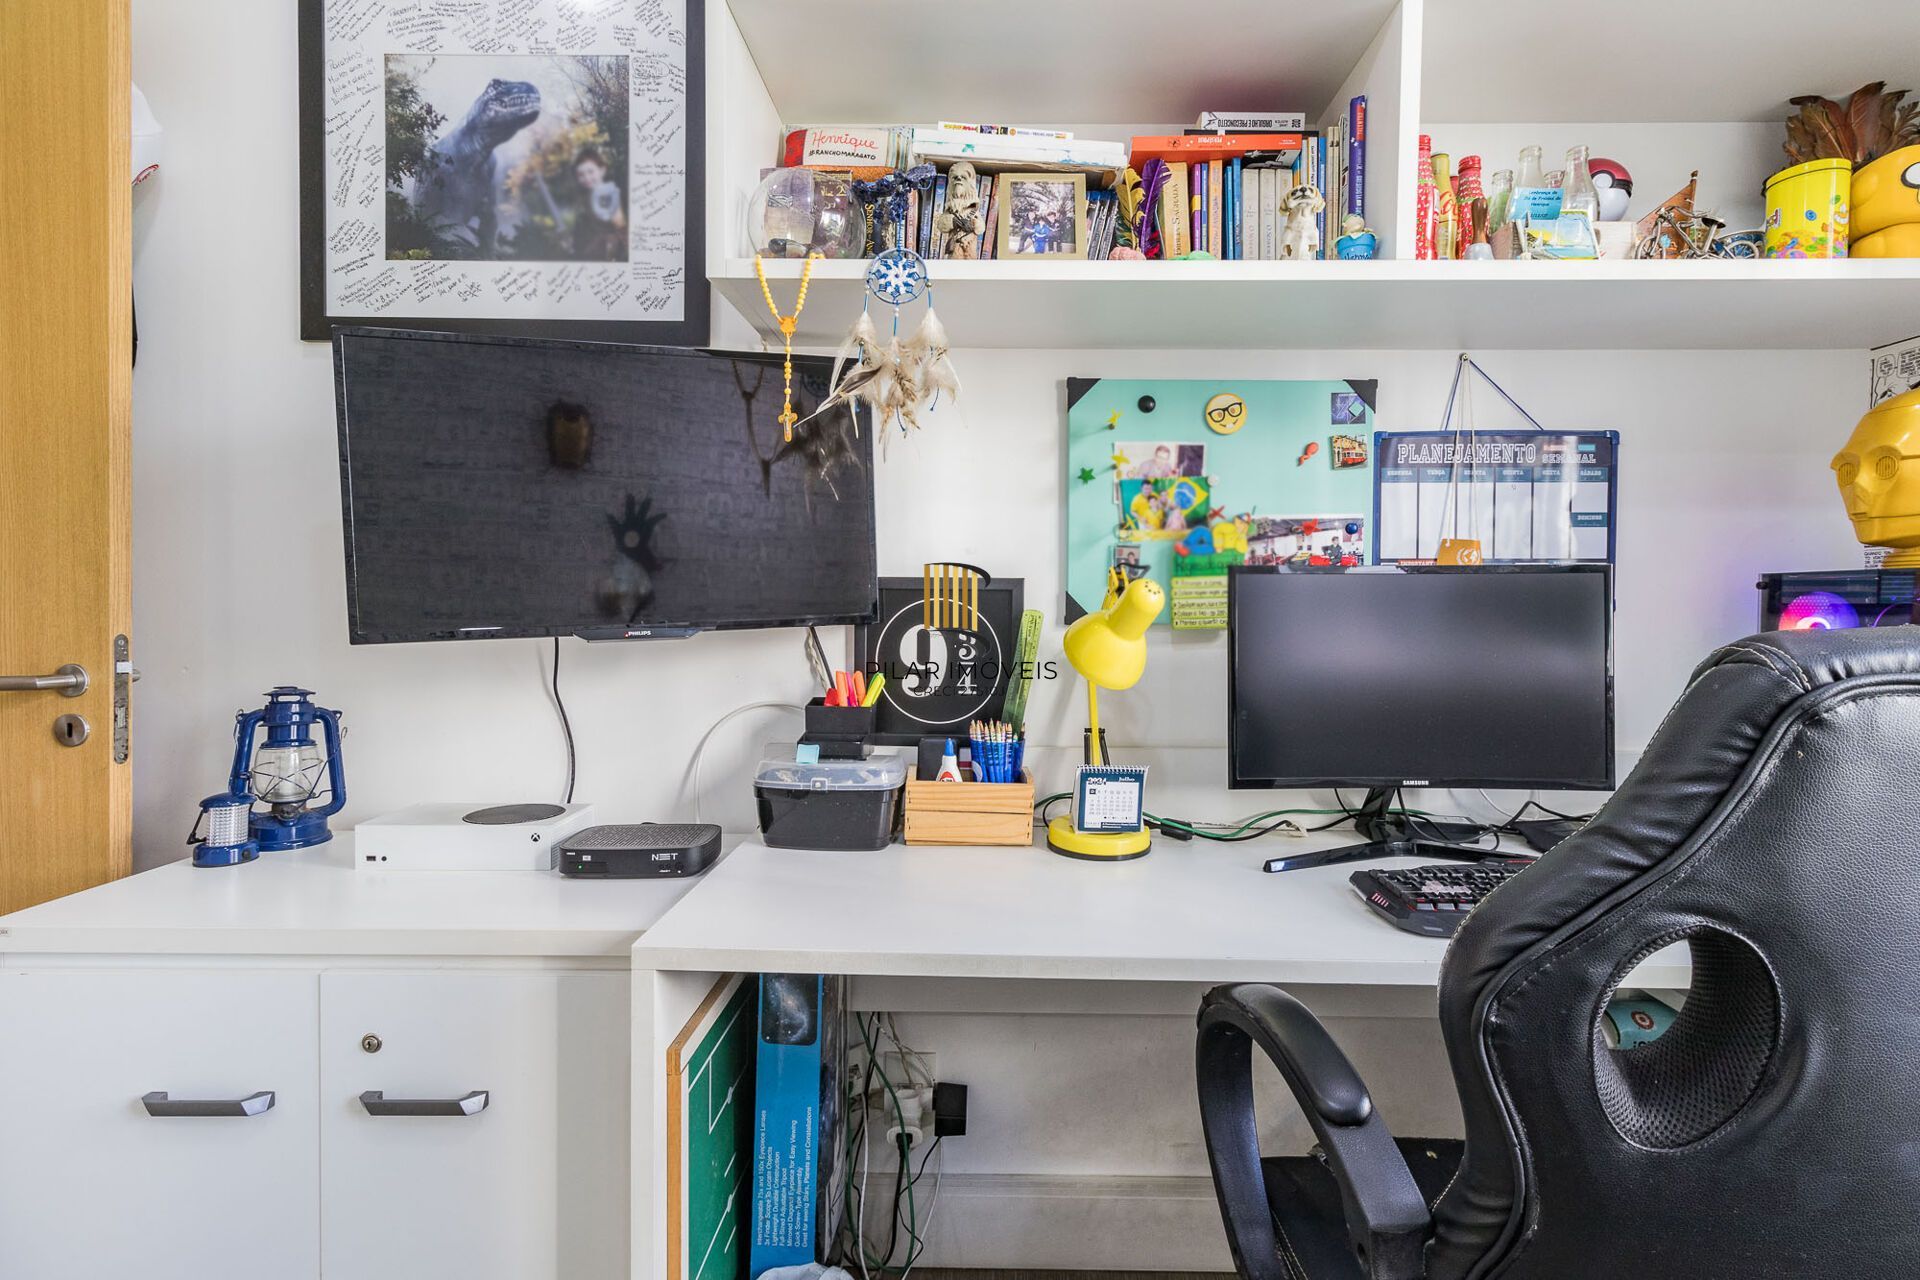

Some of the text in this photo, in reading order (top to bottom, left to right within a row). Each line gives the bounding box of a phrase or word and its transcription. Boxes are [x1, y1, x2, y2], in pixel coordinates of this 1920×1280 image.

[1218, 119, 1248, 127] PRECONCEITO
[812, 129, 879, 152] Henrique
[1397, 443, 1597, 464] PLANEJAMENTO SEMAL
[651, 852, 679, 861] NET
[765, 1238, 770, 1246] 3x
